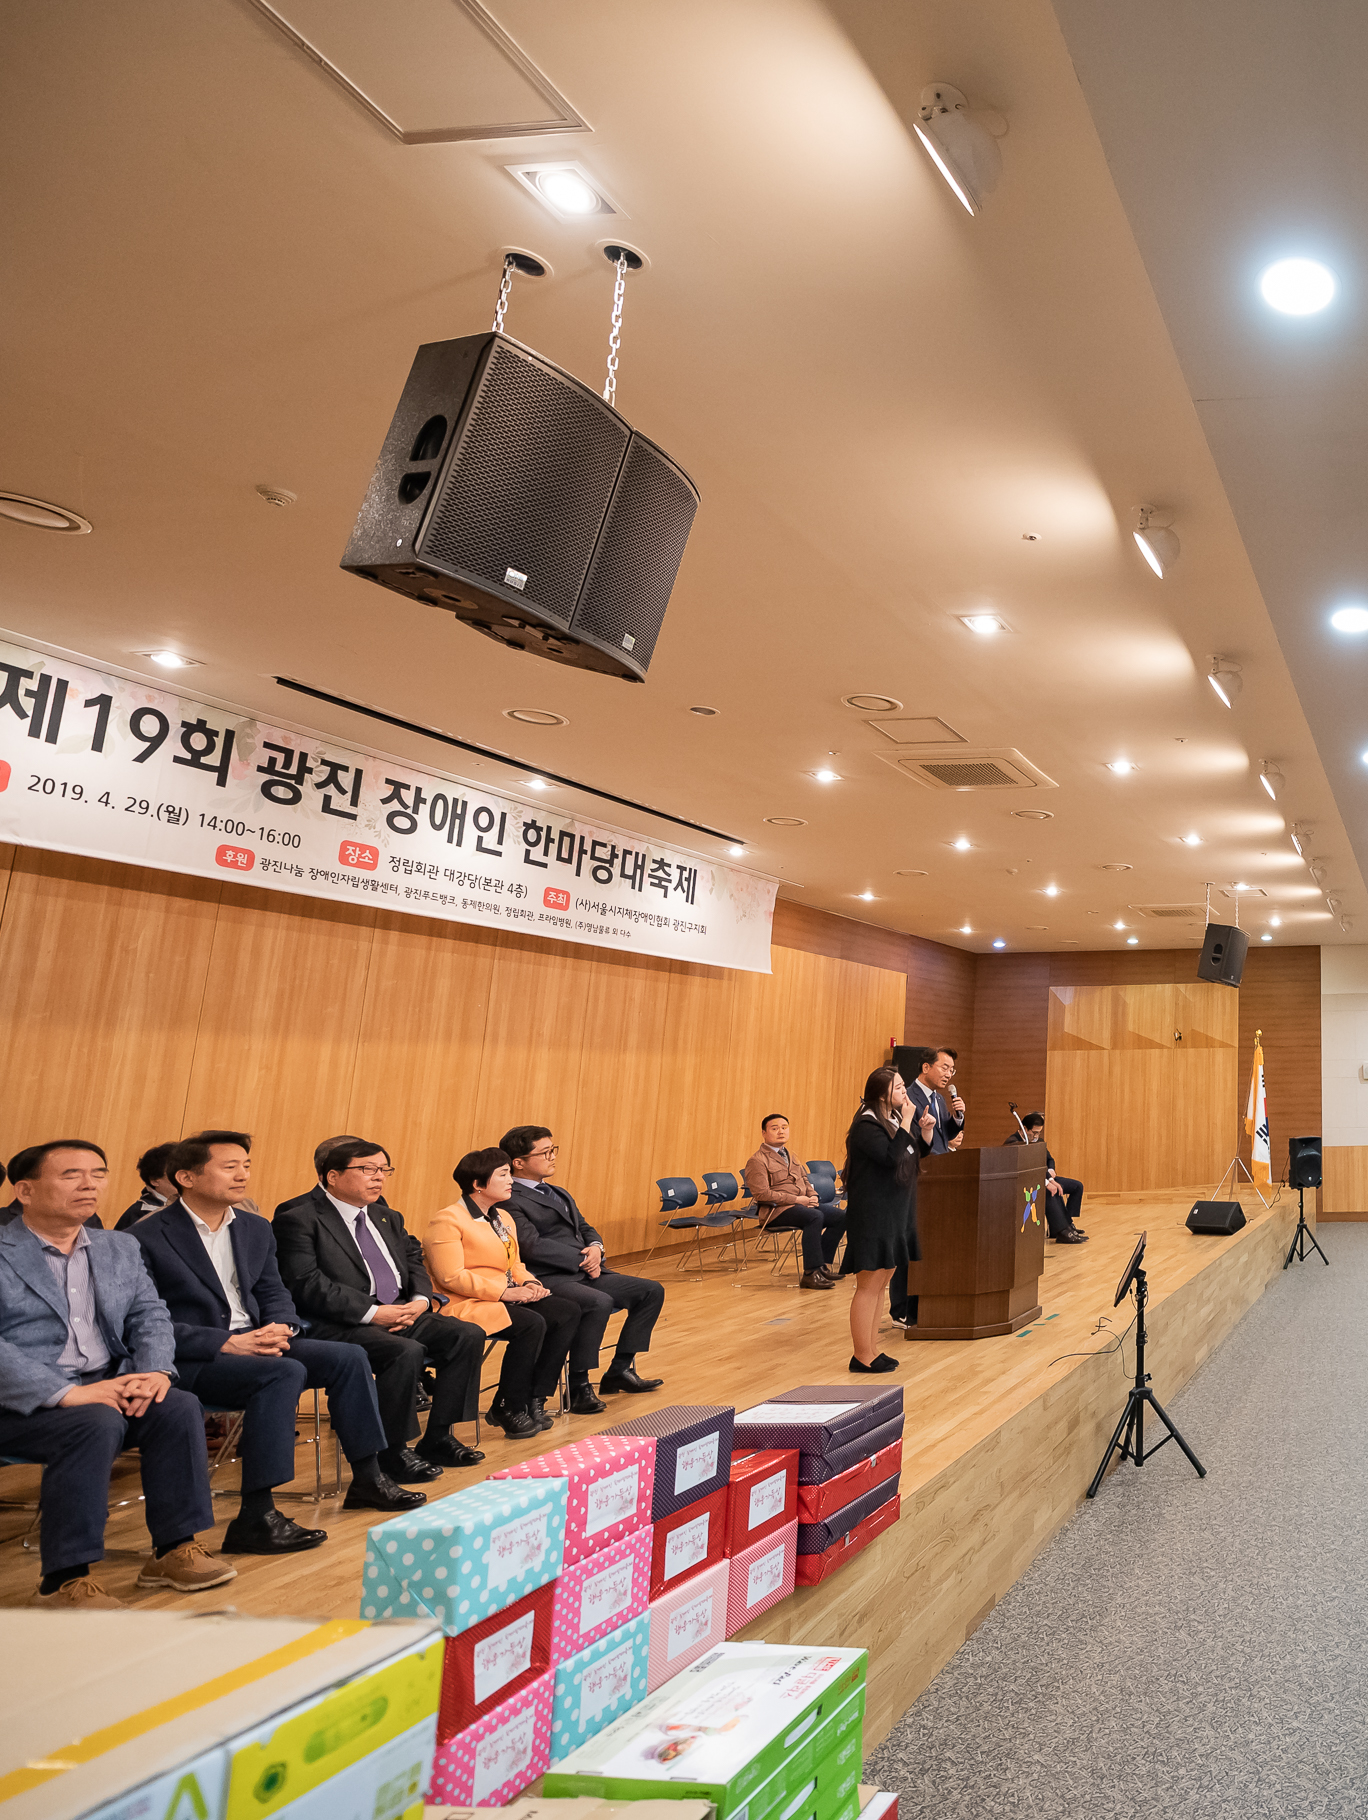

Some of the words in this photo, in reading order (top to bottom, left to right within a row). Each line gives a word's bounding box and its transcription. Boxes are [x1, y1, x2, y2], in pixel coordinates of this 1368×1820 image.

[0, 661, 236, 788] 제19회
[256, 740, 364, 821] 광진
[379, 777, 508, 858] 장애인
[522, 818, 698, 905] 한마당대축제
[27, 774, 88, 804] 2019.
[97, 791, 116, 809] 4.
[124, 796, 190, 827] 29.(월)
[198, 812, 302, 849] 14:00~16:00
[222, 849, 249, 867] 후원
[345, 845, 374, 865] 장소
[259, 857, 305, 878] 광진나눔
[308, 867, 401, 897] 장애인자립생활센터,
[403, 886, 458, 907] 광진푸드뱅크,
[504, 906, 535, 922] 정립회관,
[388, 855, 440, 881] 정립회관
[443, 868, 505, 895] 대강당(본관
[507, 882, 528, 899] 4층)
[546, 890, 567, 906] 주최
[575, 897, 670, 928] (사)서울시지체장애인협회
[672, 918, 707, 935] 광진구지회
